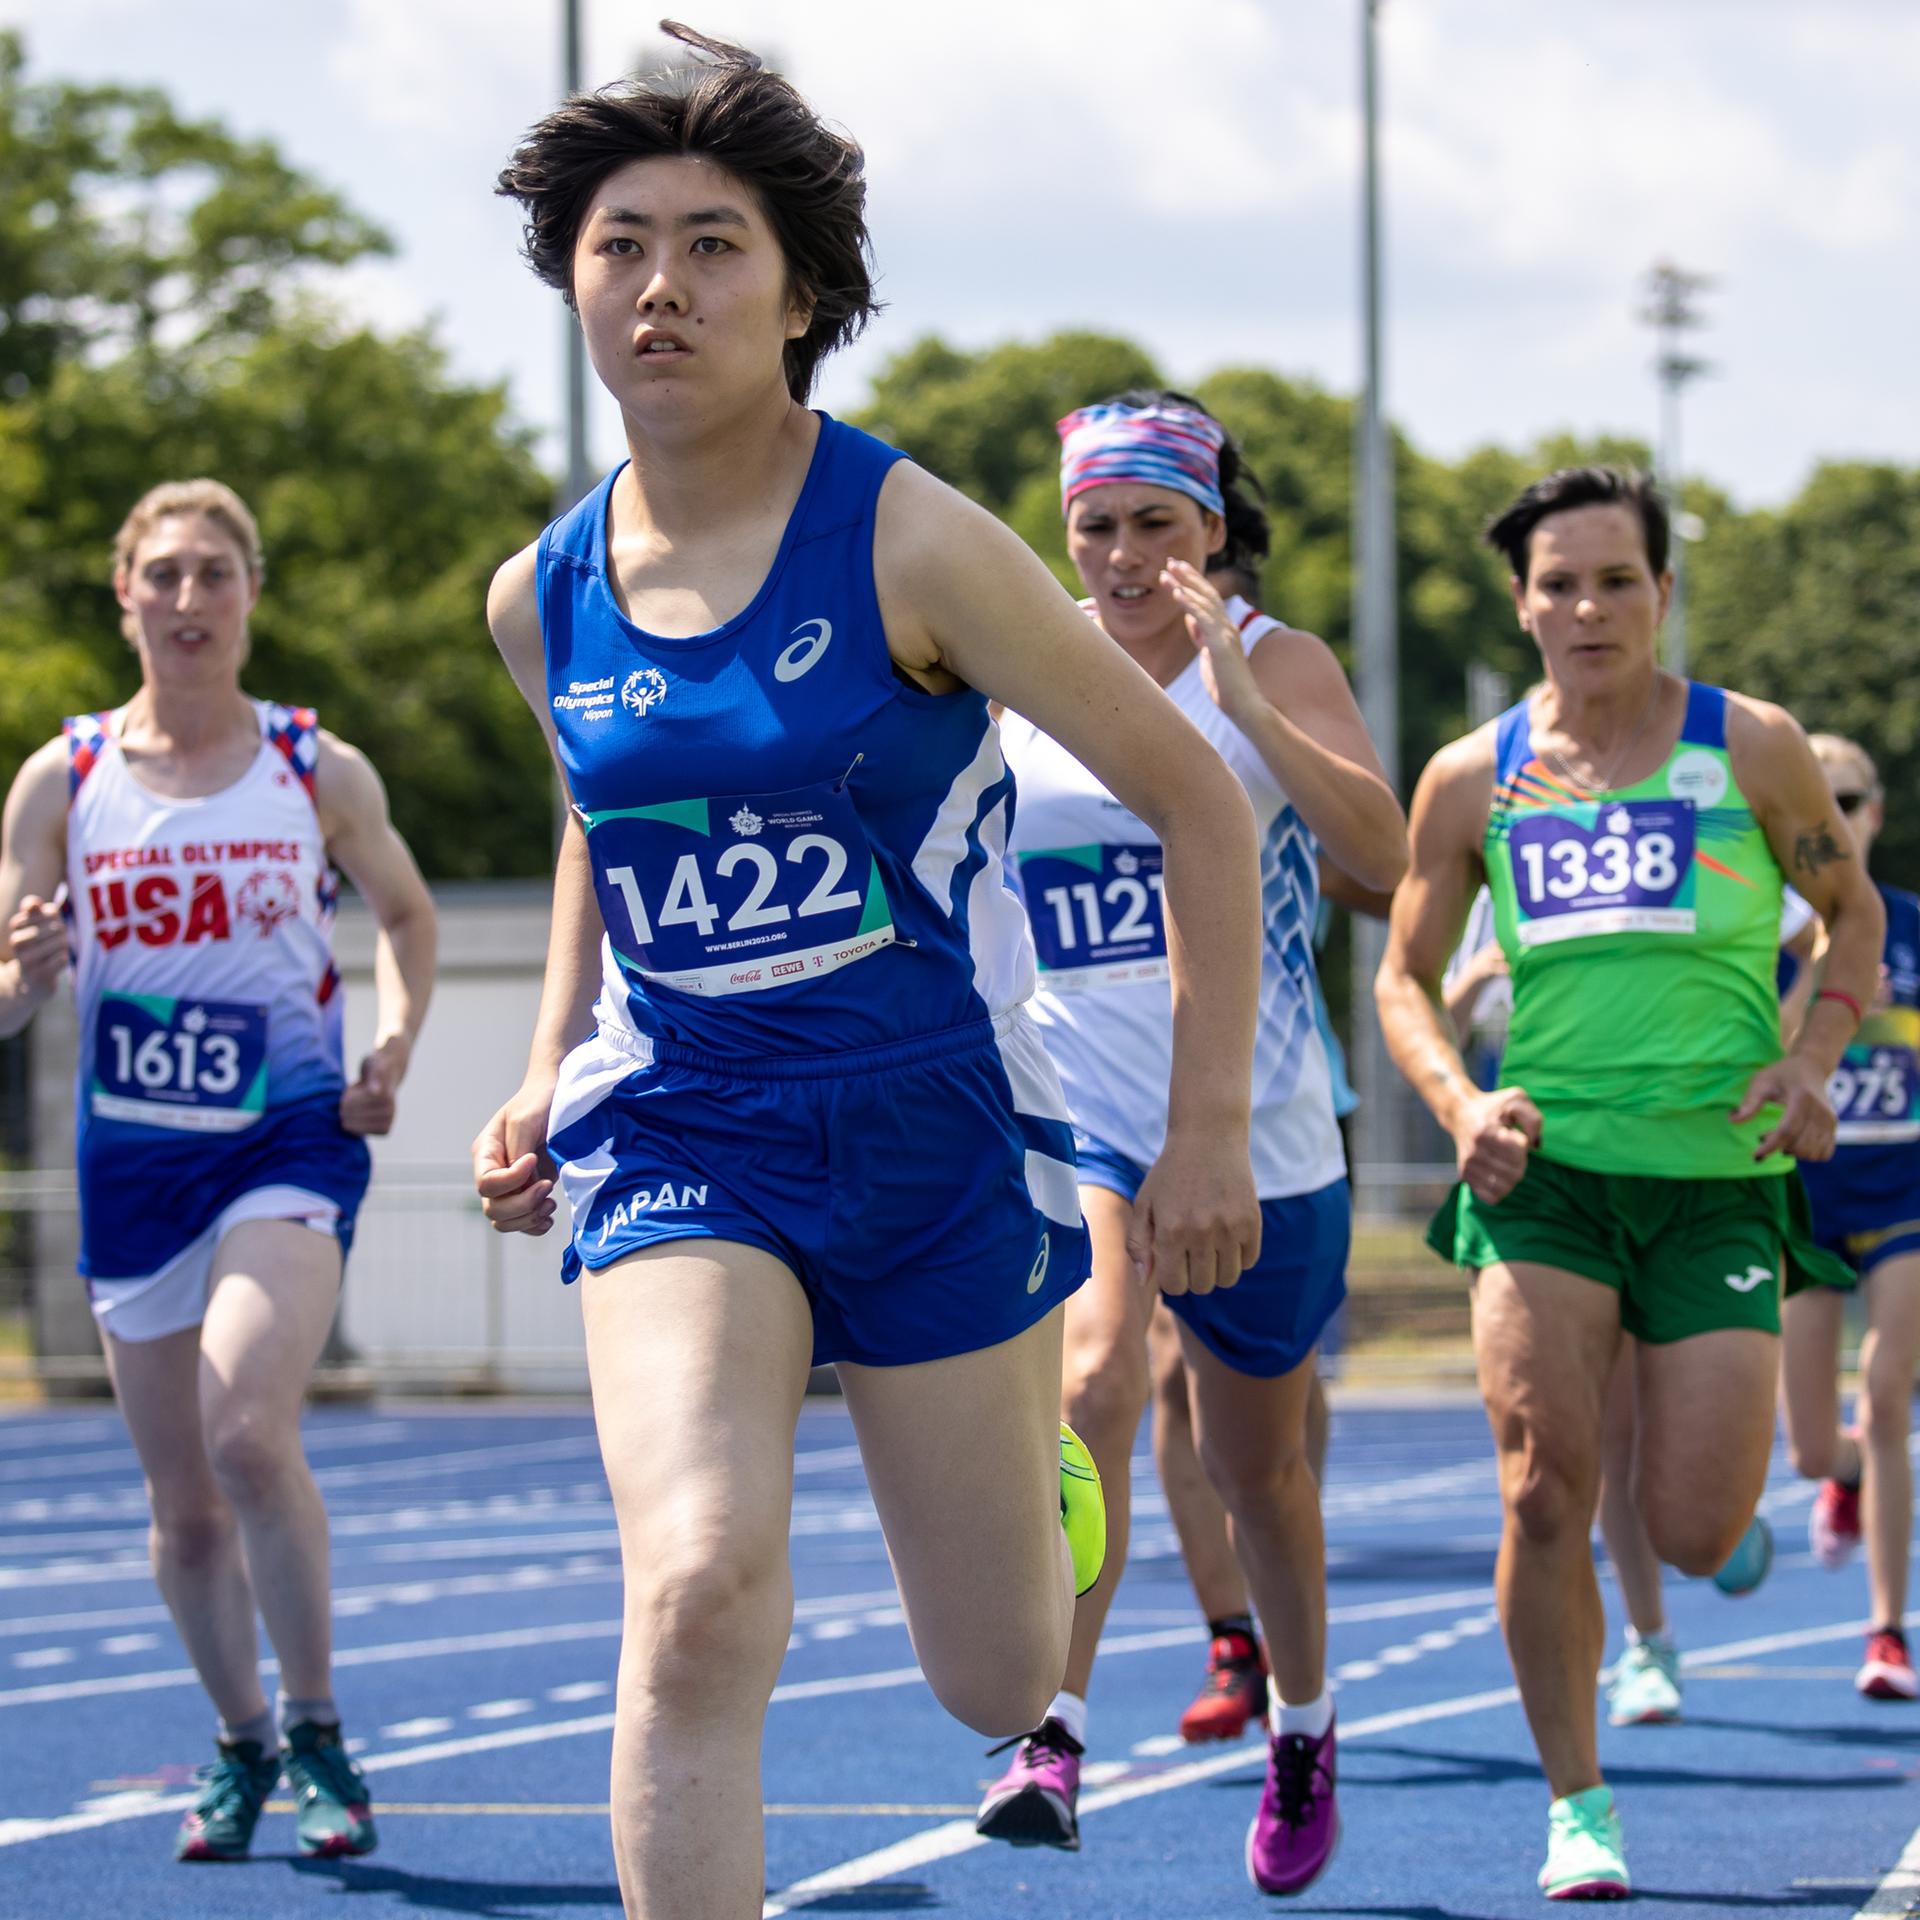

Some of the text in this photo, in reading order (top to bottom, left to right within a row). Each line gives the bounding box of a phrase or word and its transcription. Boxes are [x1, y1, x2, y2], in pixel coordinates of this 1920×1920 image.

[553, 694, 615, 710] Olympics
[568, 676, 615, 696] Special
[582, 708, 614, 721] Nippon
[796, 814, 823, 823] GAMES
[84, 840, 301, 875] SPECIAL OLYMPICS
[1519, 831, 1678, 903] 1338
[606, 833, 862, 945] 1422
[88, 872, 230, 950] USA
[705, 932, 788, 953] WWW.BERLIN2023.ORG
[773, 961, 804, 976] REWE
[832, 940, 877, 961] TOYOTA
[110, 1025, 240, 1094] 1613
[598, 1182, 708, 1248] JAPAN
